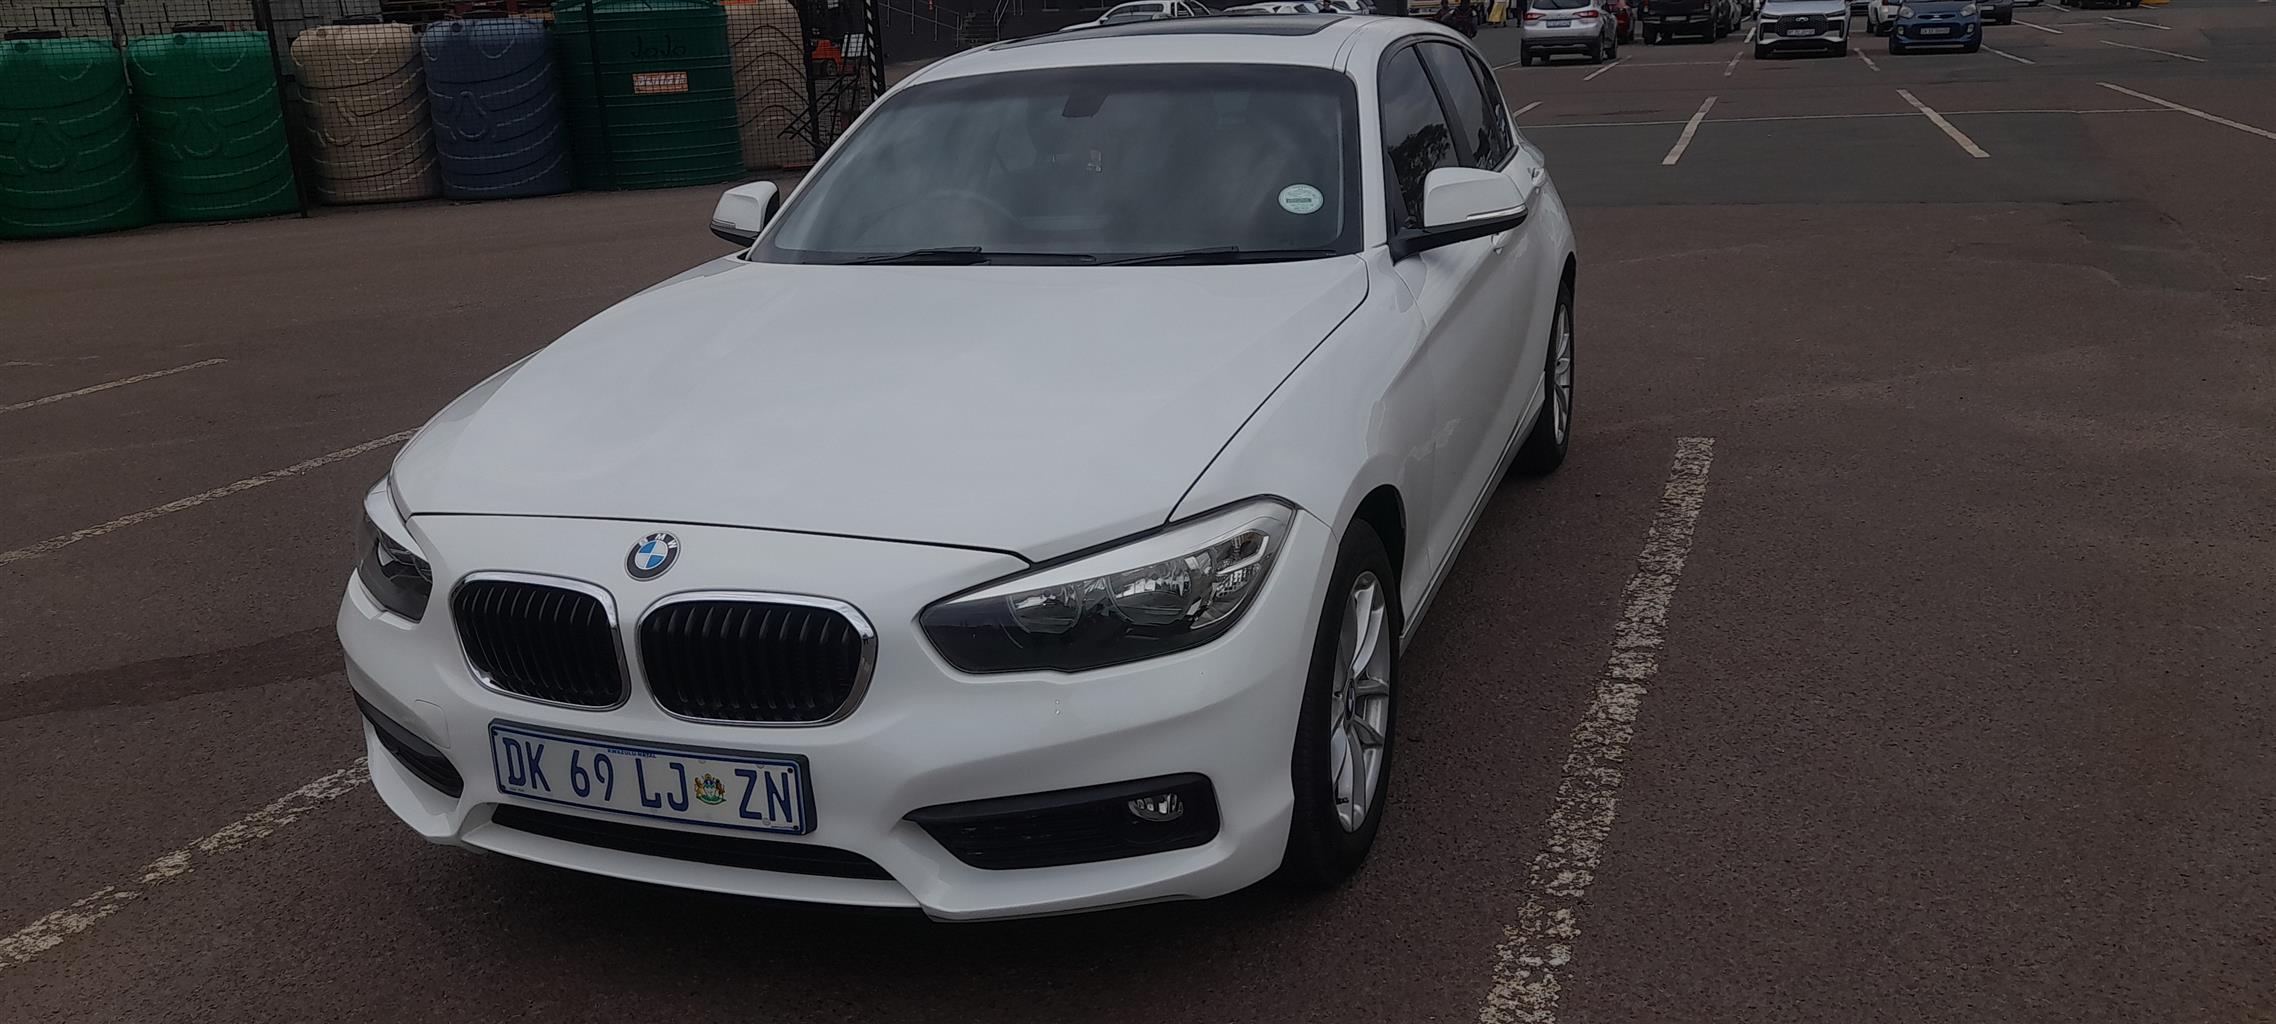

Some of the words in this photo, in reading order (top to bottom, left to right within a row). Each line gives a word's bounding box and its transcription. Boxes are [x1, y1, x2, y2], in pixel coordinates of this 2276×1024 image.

[639, 533, 678, 549] BMW
[502, 737, 551, 793] DK
[570, 749, 614, 802] 69
[635, 758, 690, 812] LJ
[734, 768, 793, 823] ZN
